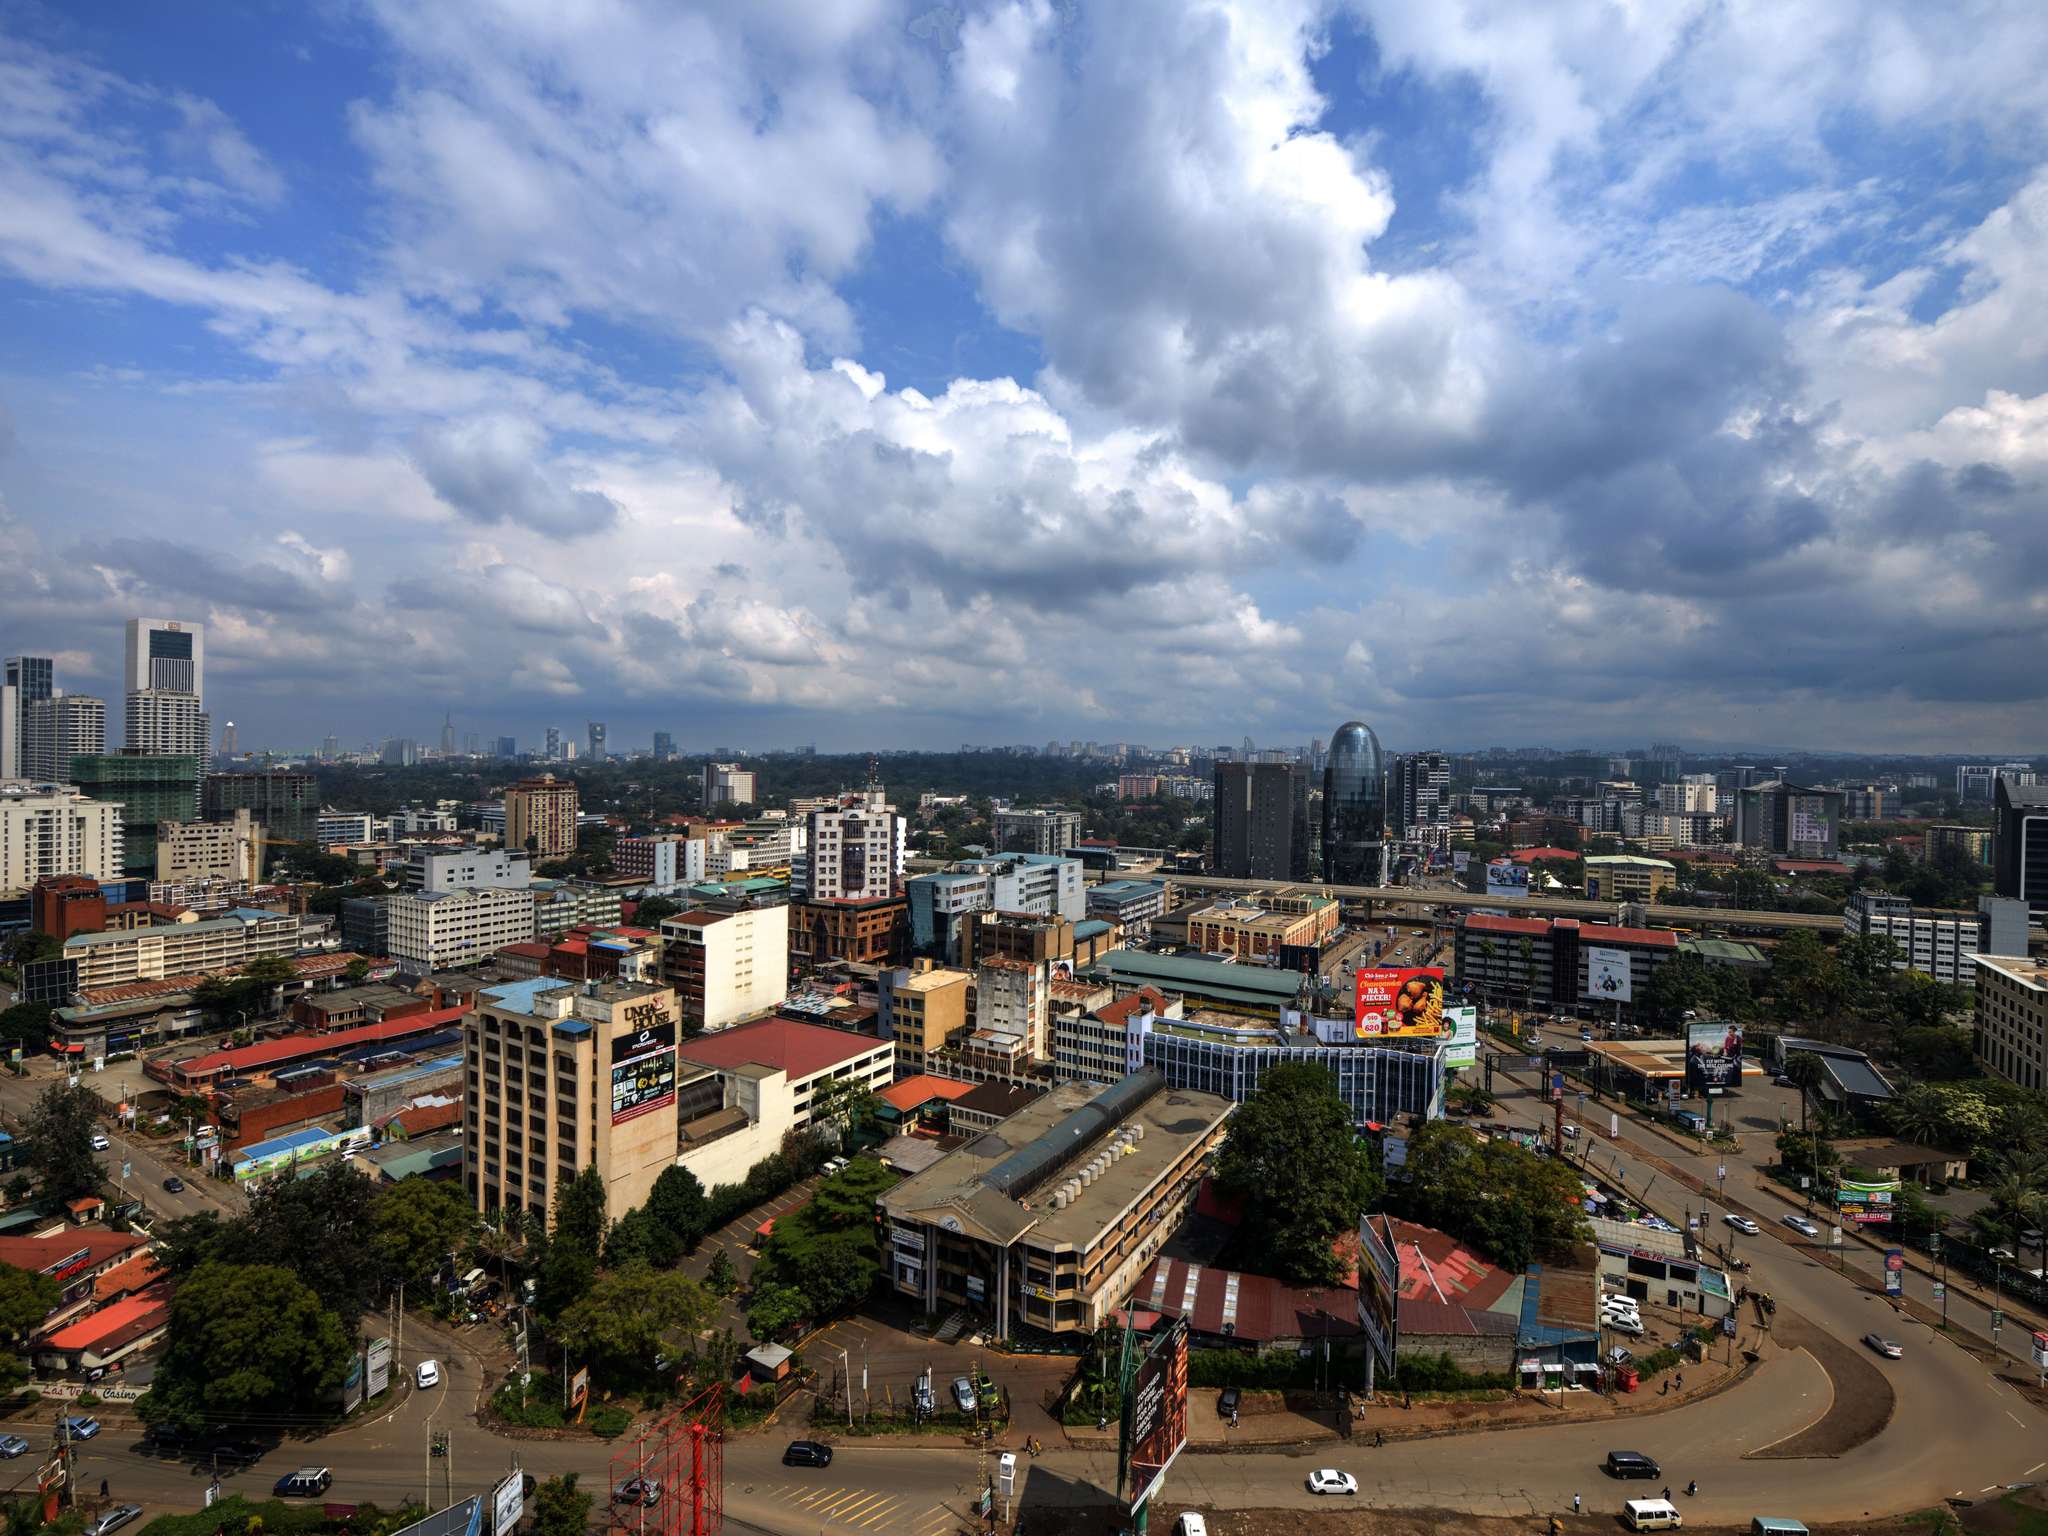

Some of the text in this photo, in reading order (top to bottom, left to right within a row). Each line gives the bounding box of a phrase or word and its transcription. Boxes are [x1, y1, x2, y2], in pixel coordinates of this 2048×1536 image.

[624, 1003, 656, 1022] UNGA
[633, 1010, 670, 1033] HOUSE
[1365, 1024, 1380, 1032] 620
[43, 1384, 63, 1396] Las
[102, 1387, 137, 1401] Casino
[1138, 1371, 1160, 1403] TOUCHED
[1136, 1406, 1147, 1424] FOR
[1136, 1403, 1157, 1435] SMOOTH
